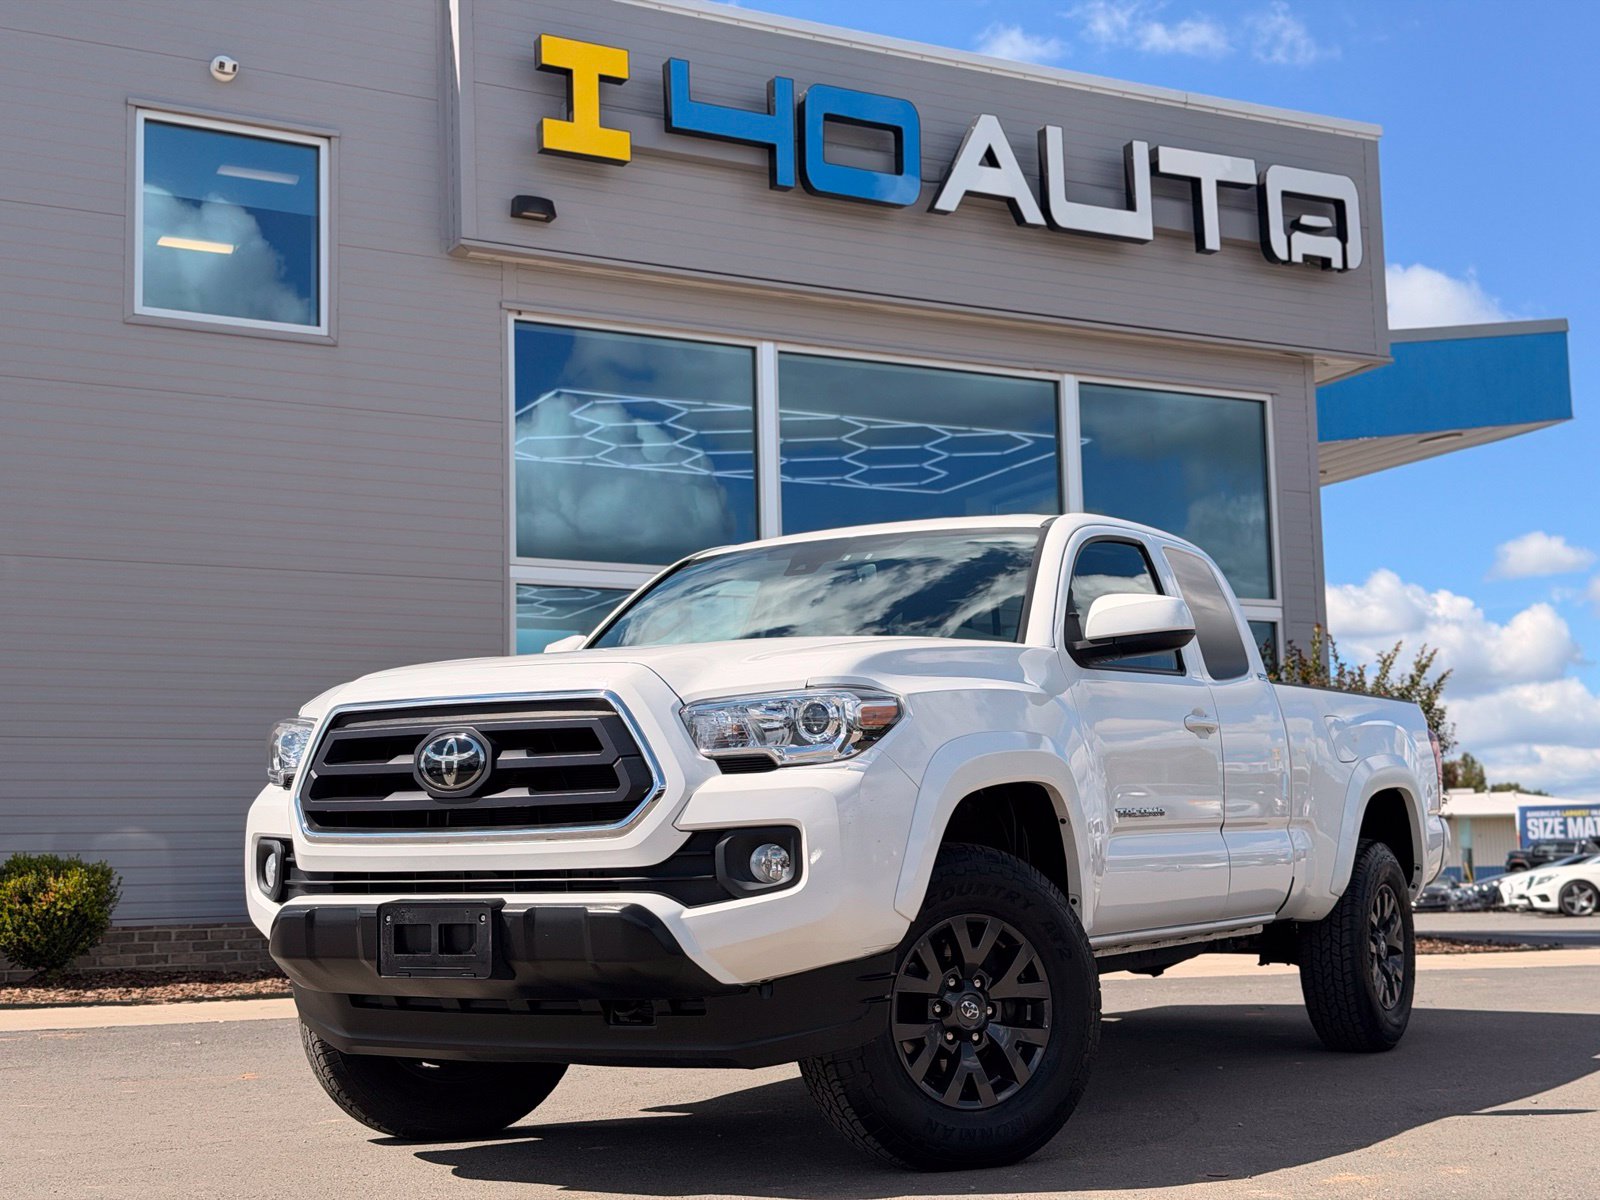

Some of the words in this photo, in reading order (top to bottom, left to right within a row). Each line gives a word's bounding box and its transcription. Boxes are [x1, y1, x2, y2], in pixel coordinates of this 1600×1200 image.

[535, 33, 632, 166] I
[663, 57, 921, 207] 40
[927, 113, 1363, 273] AUTO
[1526, 818, 1565, 840] SIZE
